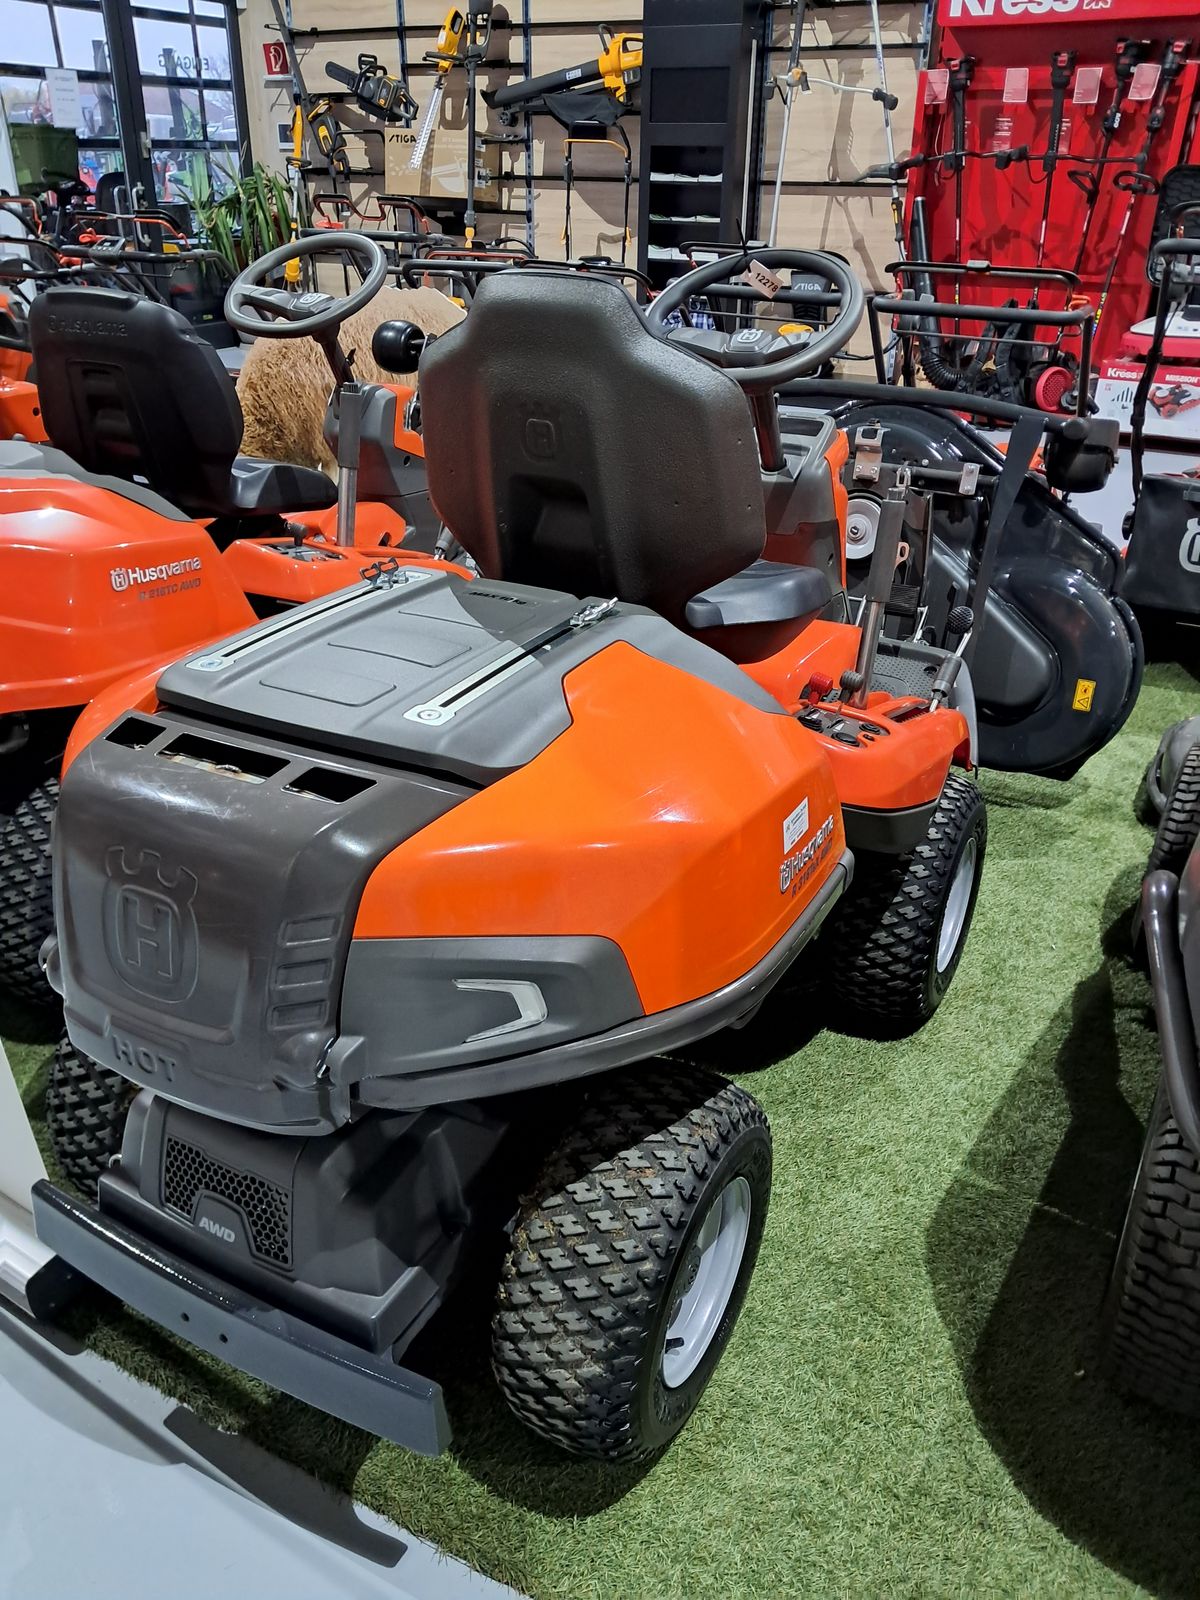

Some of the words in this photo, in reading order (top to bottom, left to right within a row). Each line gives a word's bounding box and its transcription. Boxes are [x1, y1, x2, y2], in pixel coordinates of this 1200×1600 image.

[755, 272, 779, 293] 12278
[793, 283, 822, 292] STIGA
[1106, 367, 1138, 380] Kress
[128, 556, 202, 586] Husqvarna
[790, 813, 834, 881] Husqvarna
[112, 1034, 177, 1083] HOT
[198, 1216, 236, 1243] AWD
